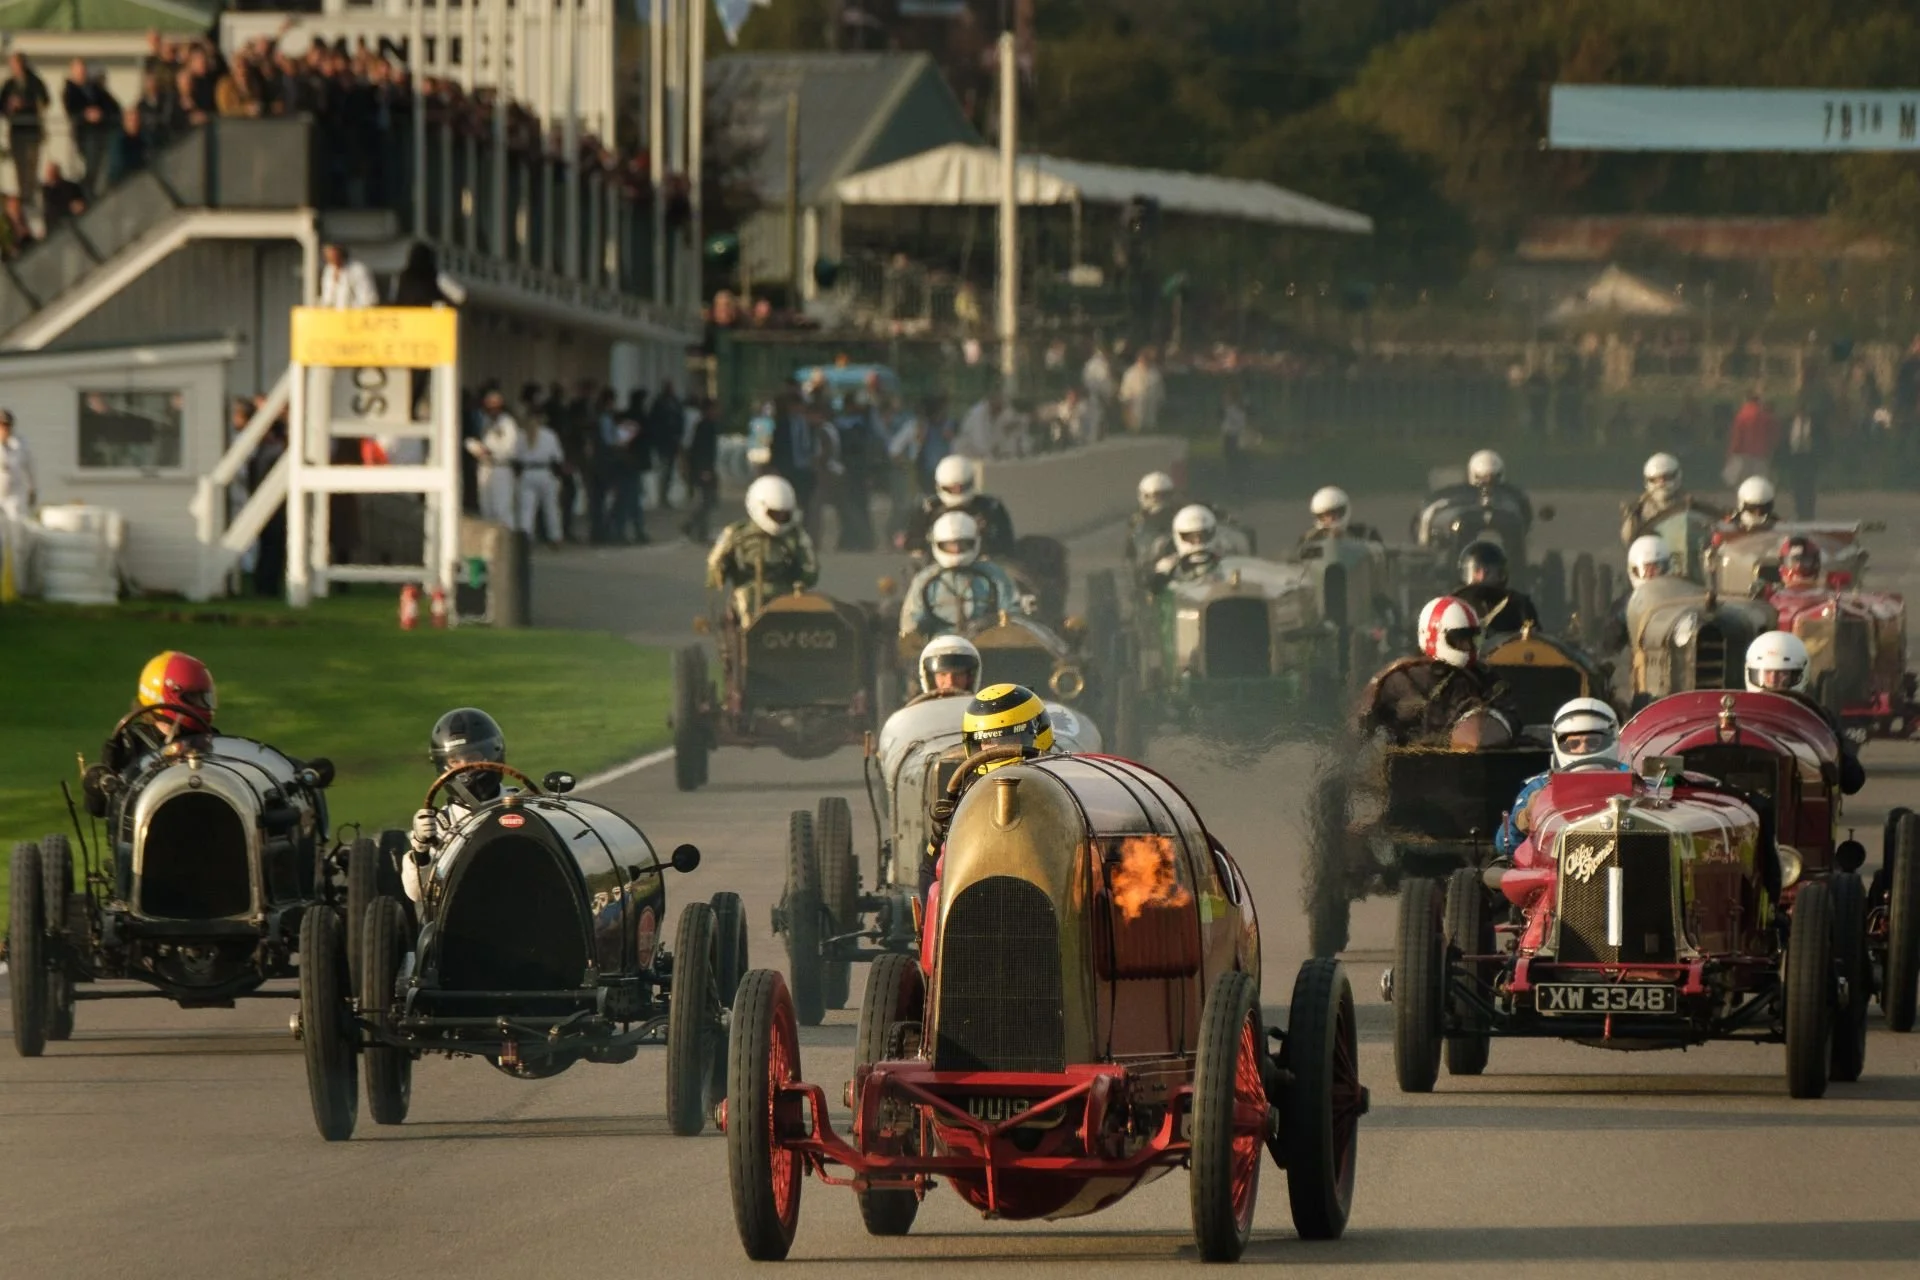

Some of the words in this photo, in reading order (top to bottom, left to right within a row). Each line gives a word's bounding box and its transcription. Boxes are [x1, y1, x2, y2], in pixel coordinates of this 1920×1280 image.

[1580, 840, 1615, 884] Romeo
[1549, 987, 1585, 1010] XW
[1592, 987, 1665, 1010] 3348
